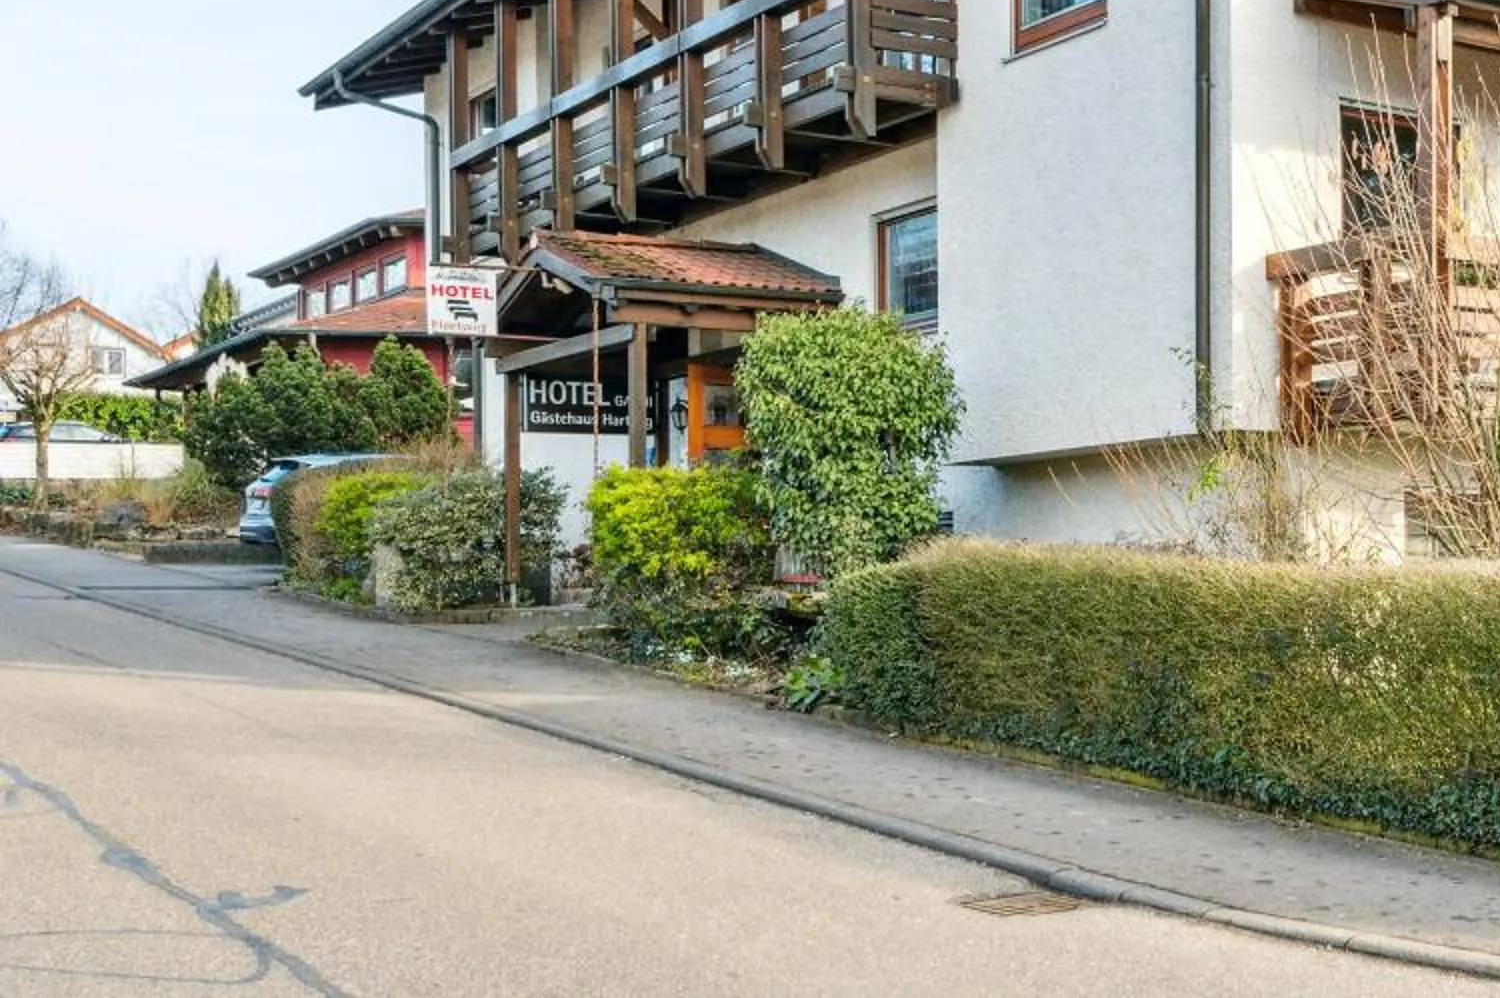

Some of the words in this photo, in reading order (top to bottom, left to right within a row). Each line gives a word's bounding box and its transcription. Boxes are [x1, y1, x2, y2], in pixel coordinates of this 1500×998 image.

[431, 284, 494, 300] HOTEL
[530, 380, 610, 406] HOTEL
[602, 413, 653, 430] Hartg
